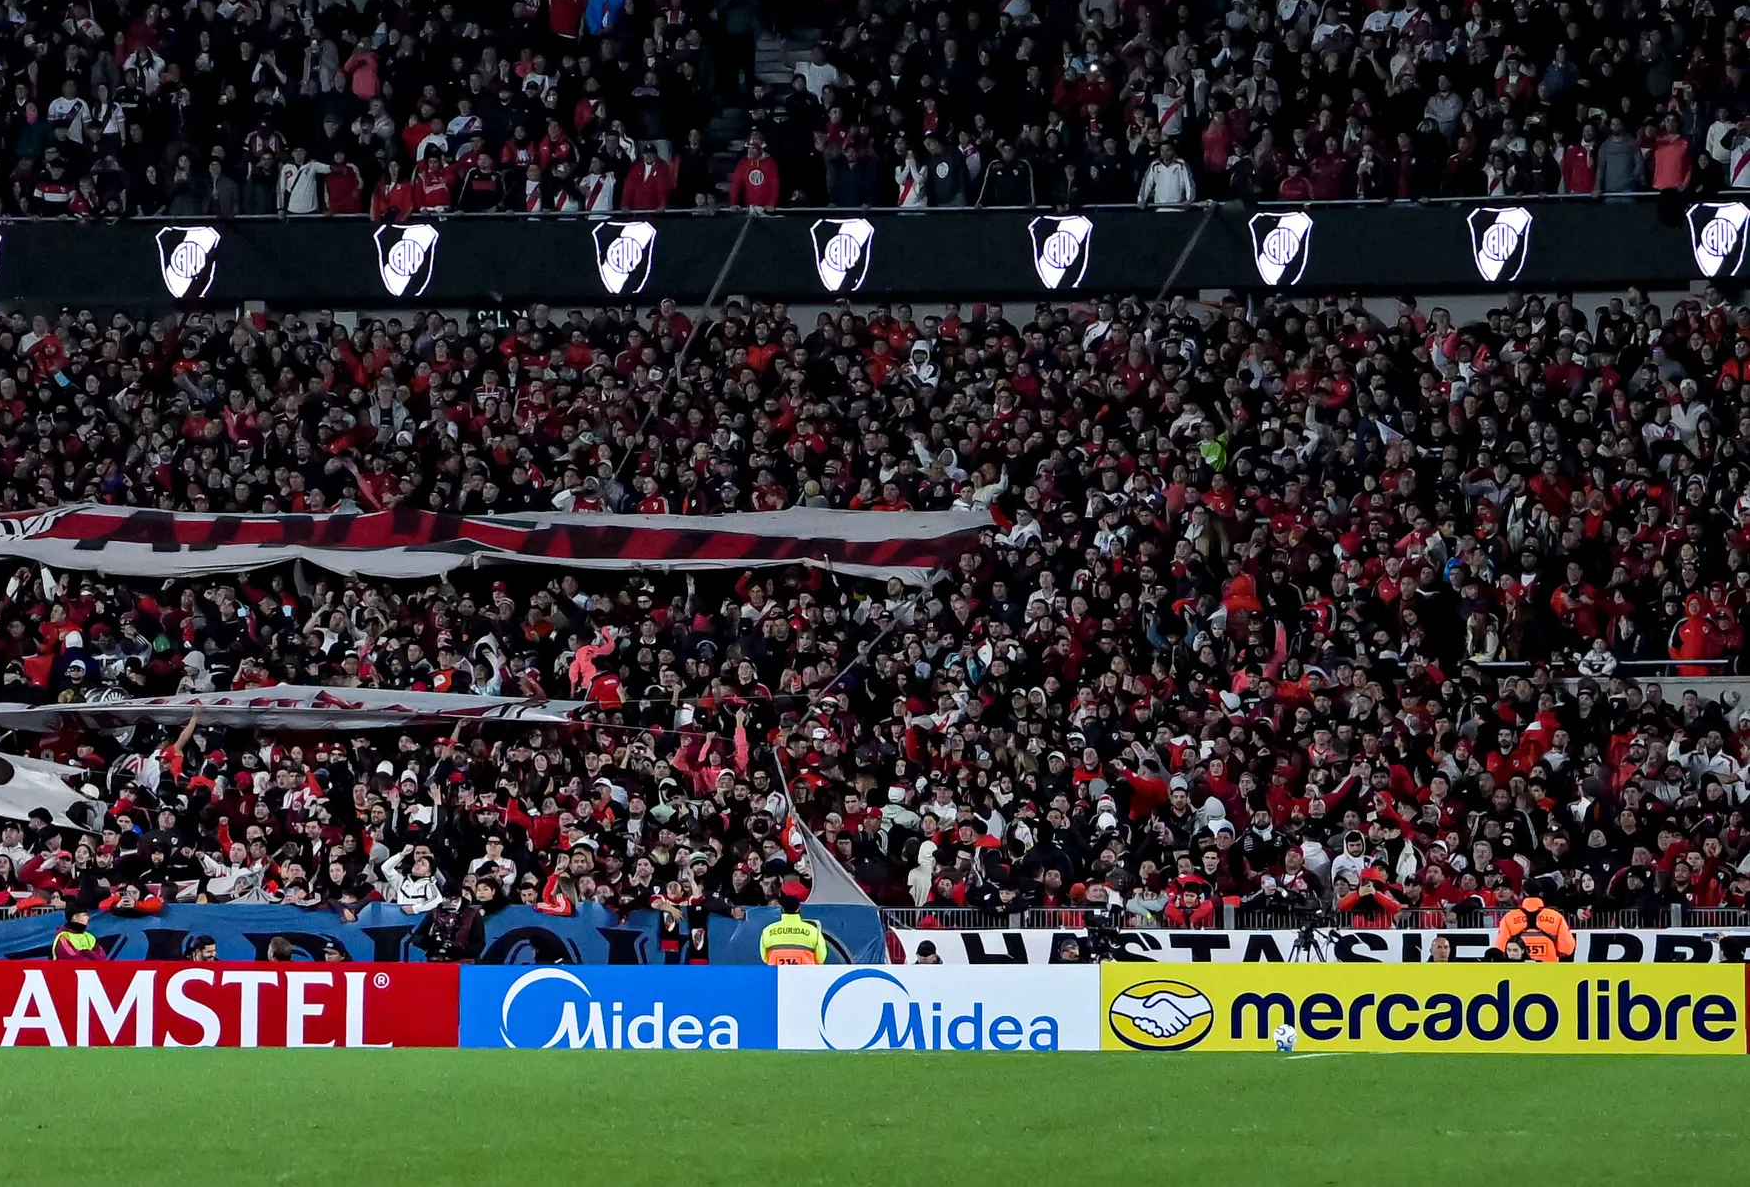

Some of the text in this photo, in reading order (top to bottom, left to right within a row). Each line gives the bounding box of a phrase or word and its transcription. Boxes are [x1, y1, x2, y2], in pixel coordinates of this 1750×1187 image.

[769, 927, 811, 937] SEGURIDAD
[545, 1002, 738, 1049] Midea
[866, 1002, 1059, 1051] Midea
[1230, 979, 1737, 1043] mercado libre
